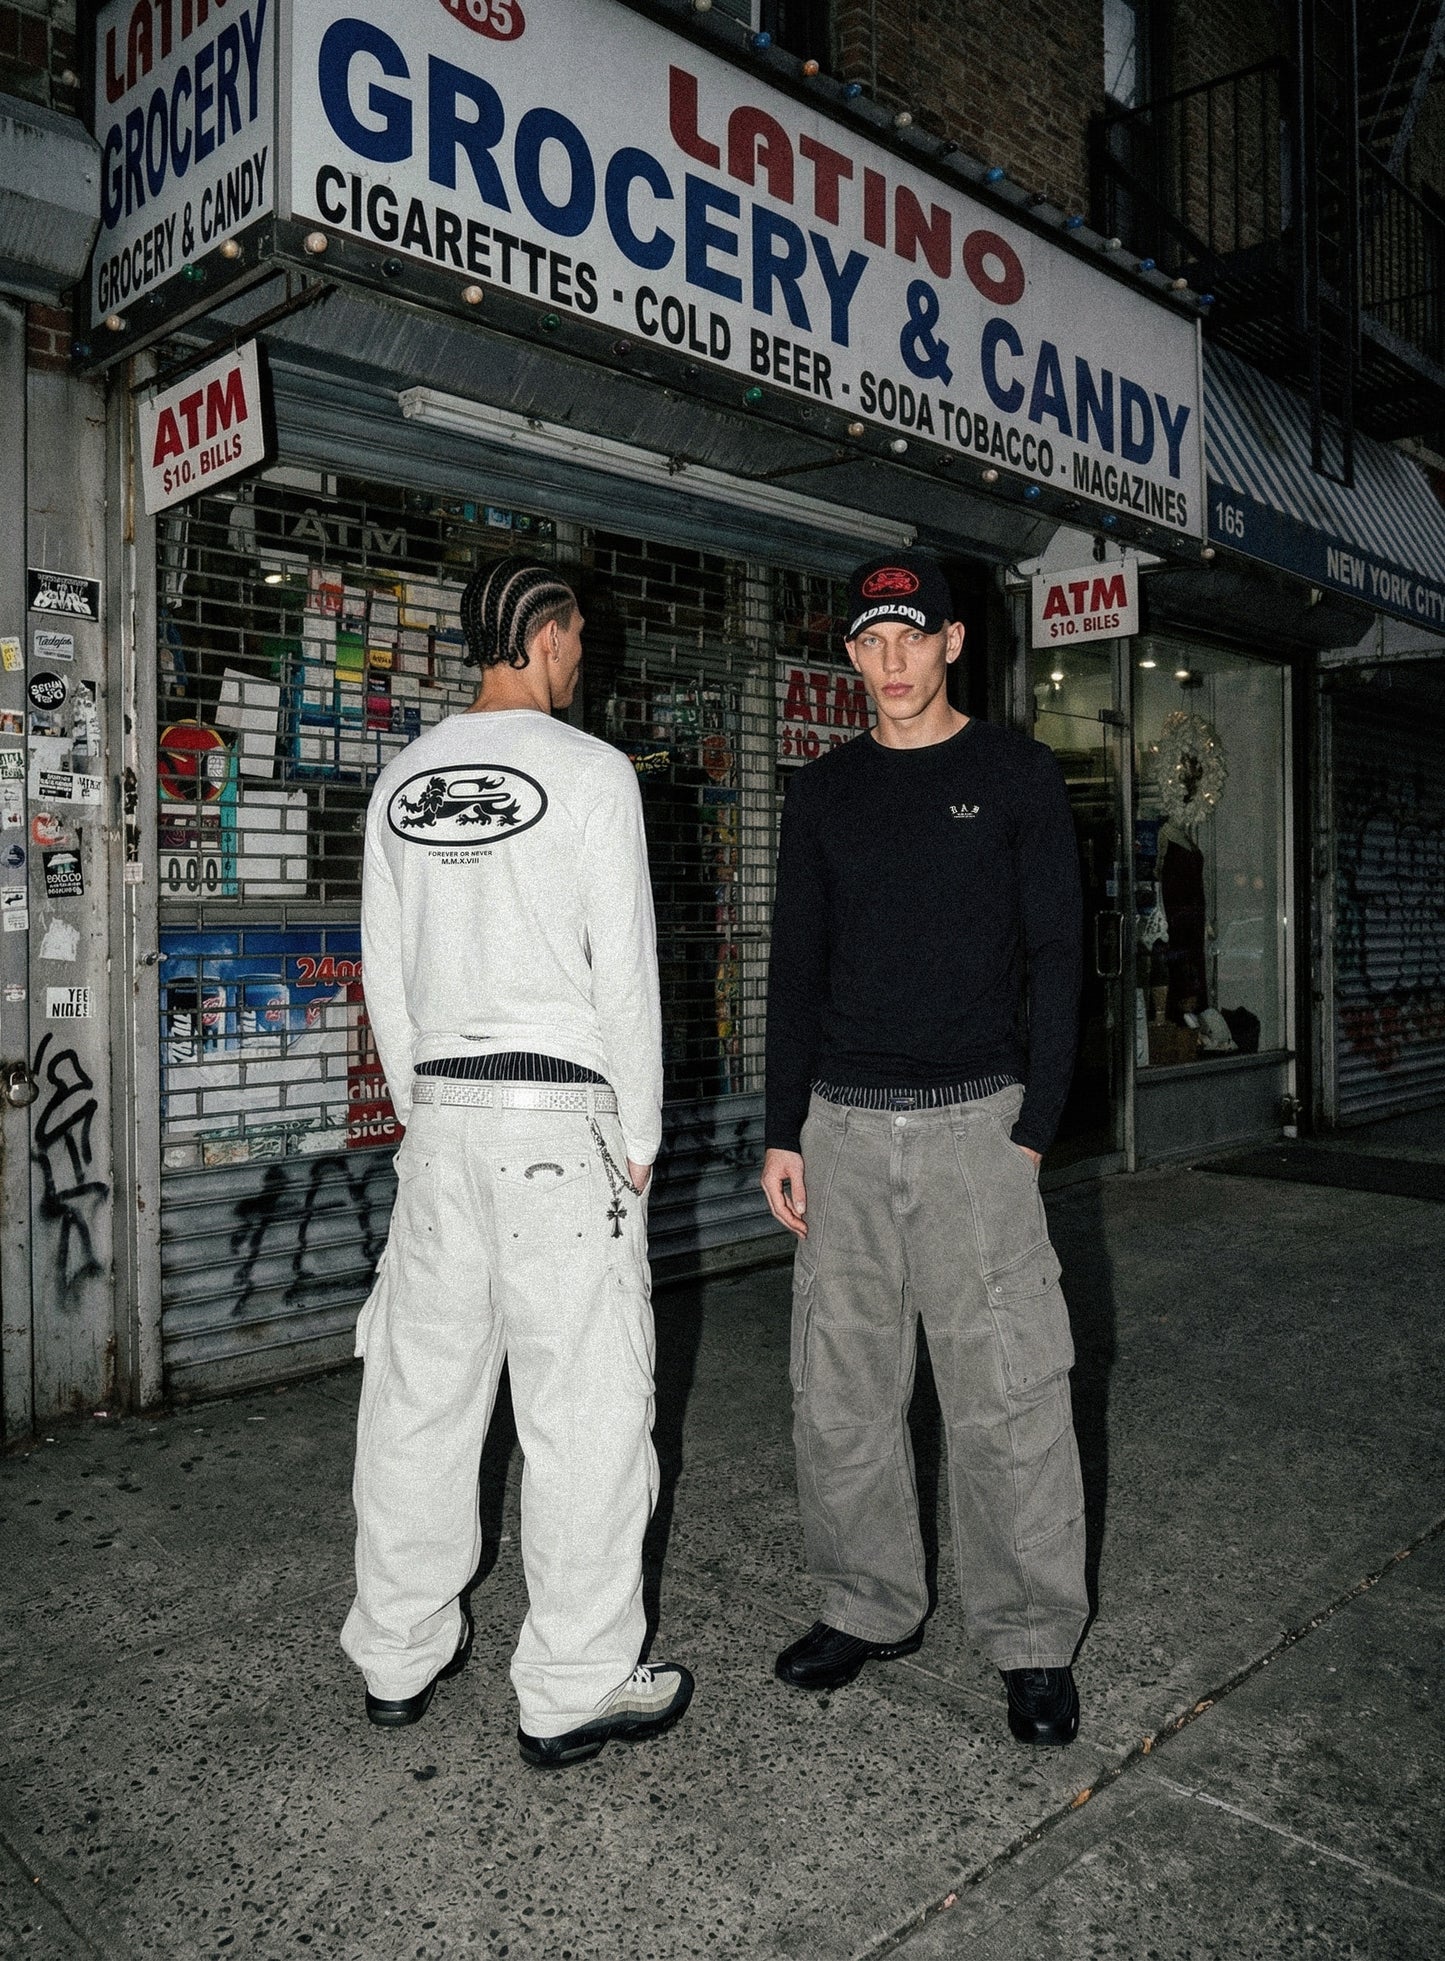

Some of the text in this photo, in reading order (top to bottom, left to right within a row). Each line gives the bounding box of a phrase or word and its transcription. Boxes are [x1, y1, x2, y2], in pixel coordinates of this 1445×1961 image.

[450, 0, 513, 34] 65
[101, 0, 268, 230] GROCERY
[669, 64, 1026, 306] LATINO
[99, 145, 268, 313] GROCERY & CANDY
[318, 17, 1192, 480] GROCERY & CANDY
[315, 164, 1188, 528] CIGARETTES COLD BEER SODA TOBACCO MAGAZINES
[153, 367, 249, 468] ATM
[163, 433, 242, 495] $10. BILLS
[290, 507, 408, 560] ATM
[1216, 501, 1245, 538] 165
[1042, 574, 1128, 620] ATM
[1327, 546, 1445, 622] NEW YORK CITY
[1050, 620, 1079, 638] $10.
[783, 669, 870, 729] ATM
